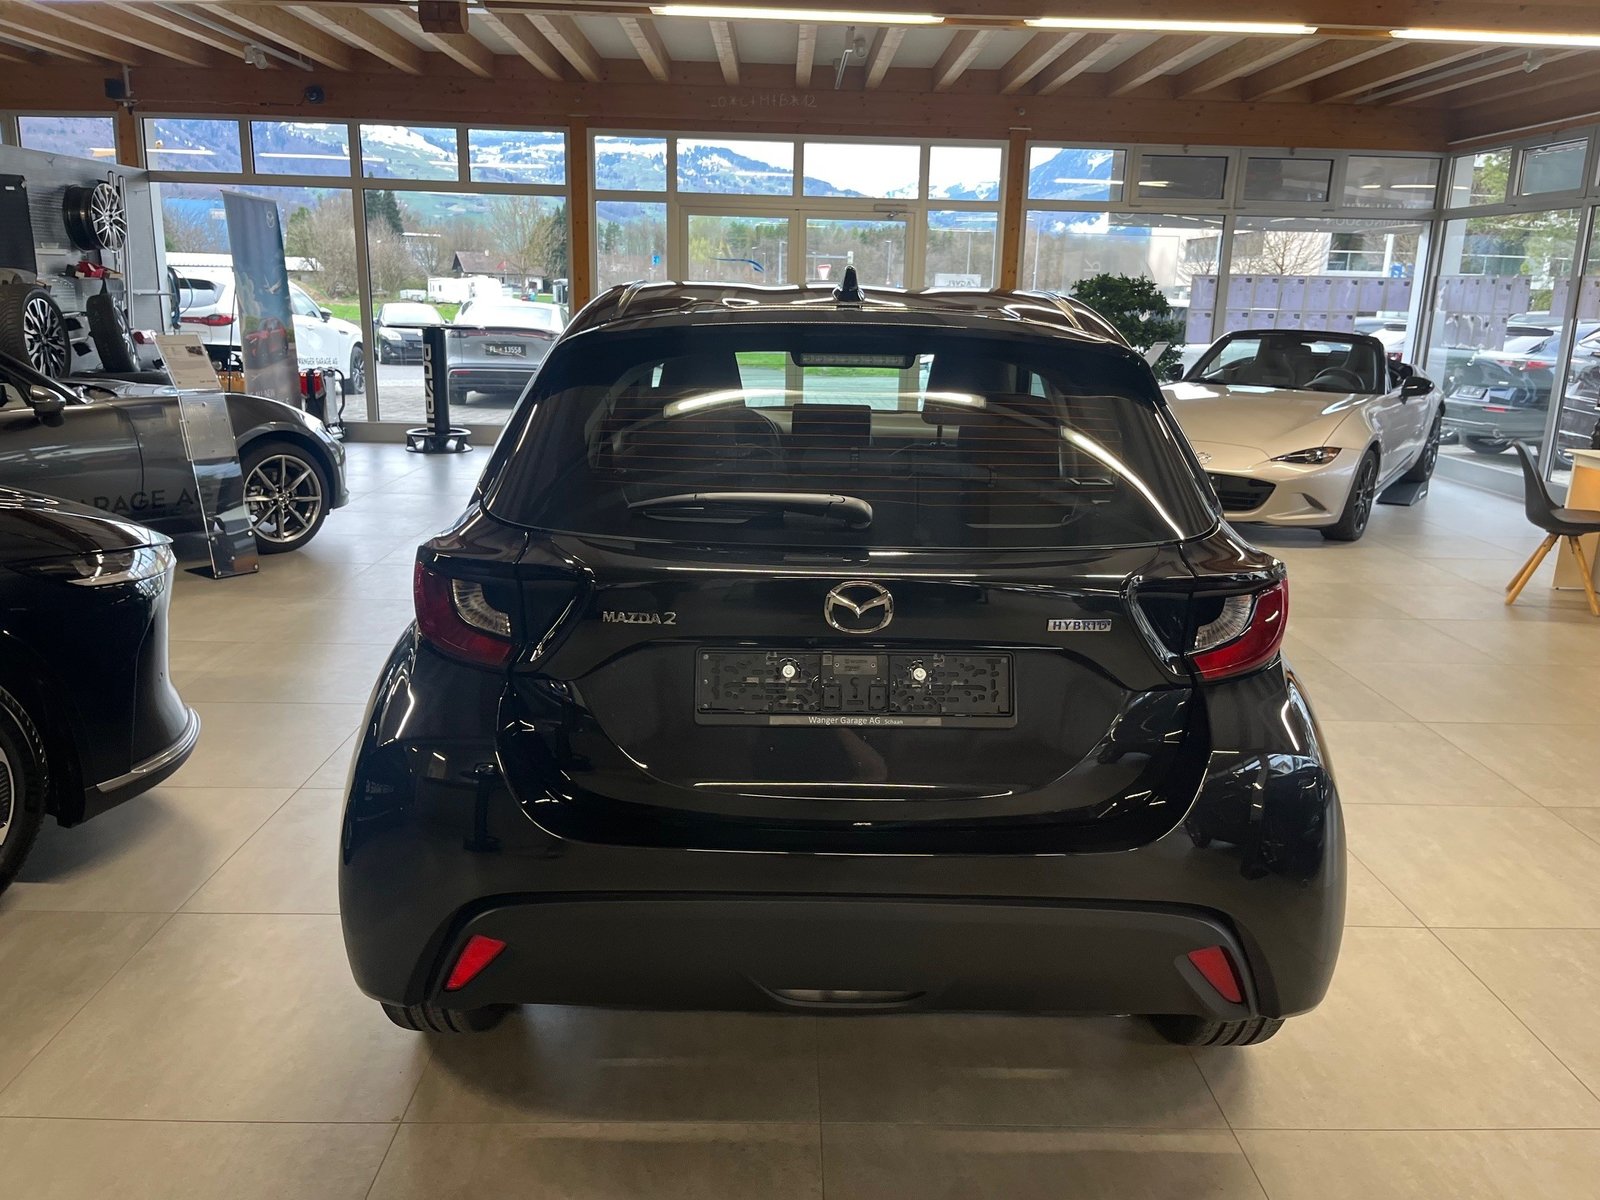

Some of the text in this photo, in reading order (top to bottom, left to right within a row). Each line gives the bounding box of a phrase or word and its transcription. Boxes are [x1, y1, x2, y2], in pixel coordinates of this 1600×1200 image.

[1052, 620, 1107, 630] HYBRID
[808, 716, 838, 726] Wanger
[840, 716, 868, 726] Garage
[869, 717, 881, 725] AG
